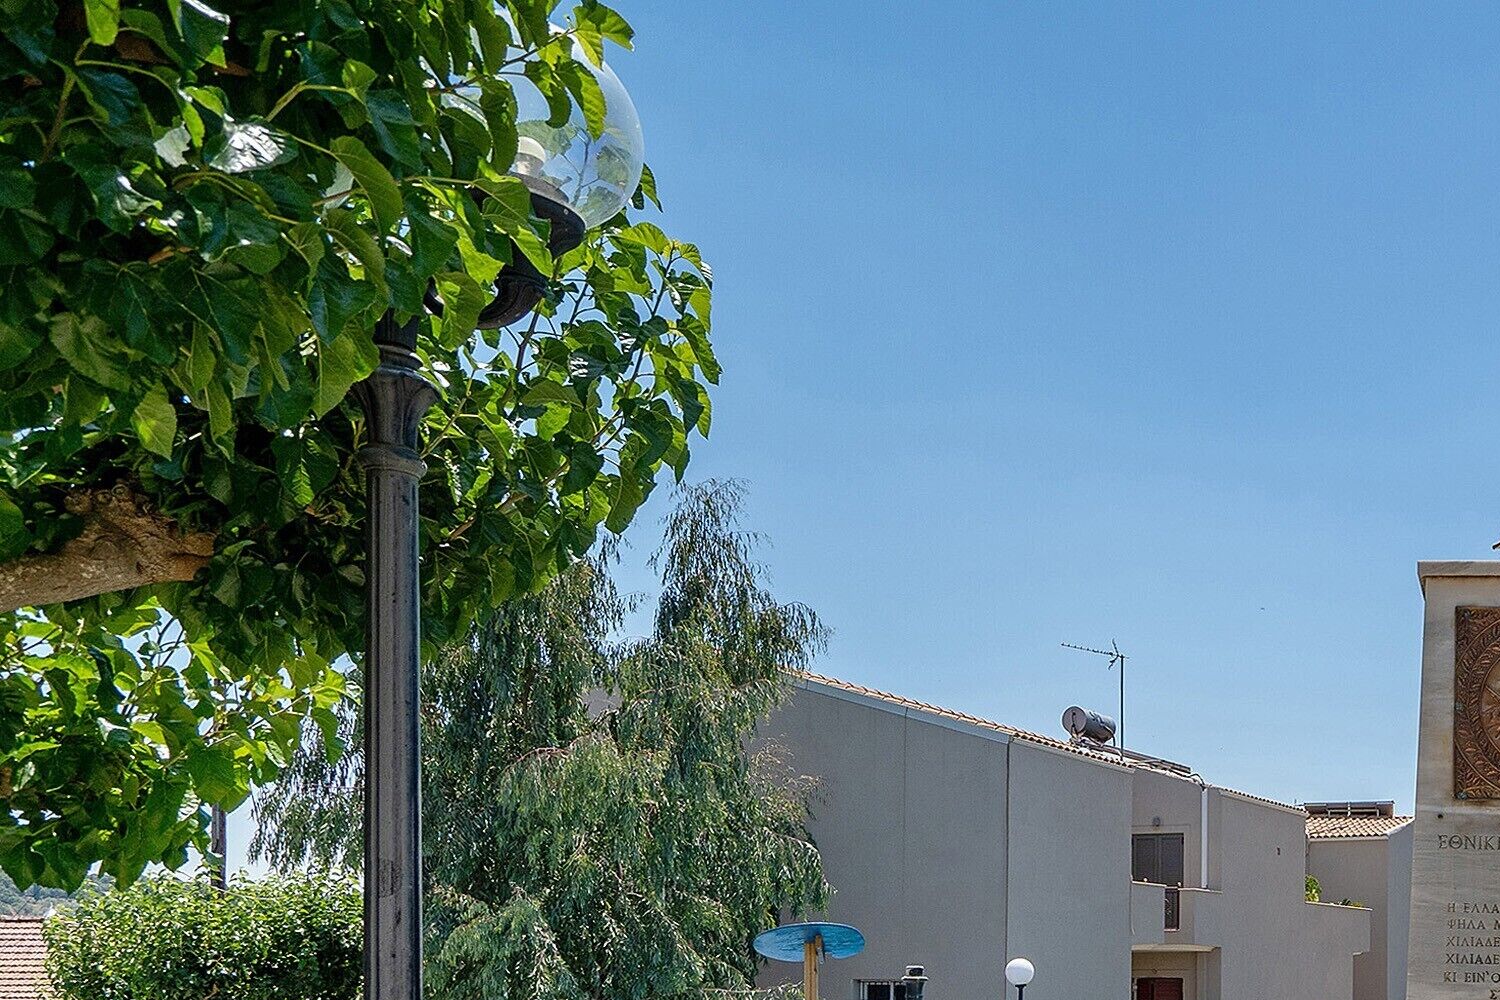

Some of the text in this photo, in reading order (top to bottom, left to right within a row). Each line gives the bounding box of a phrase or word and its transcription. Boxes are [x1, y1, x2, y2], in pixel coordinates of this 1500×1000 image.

[1447, 902, 1456, 913] Η
[1447, 918, 1486, 930] ΨΗΛΑ
[1443, 971, 1457, 983] ΚΙ
